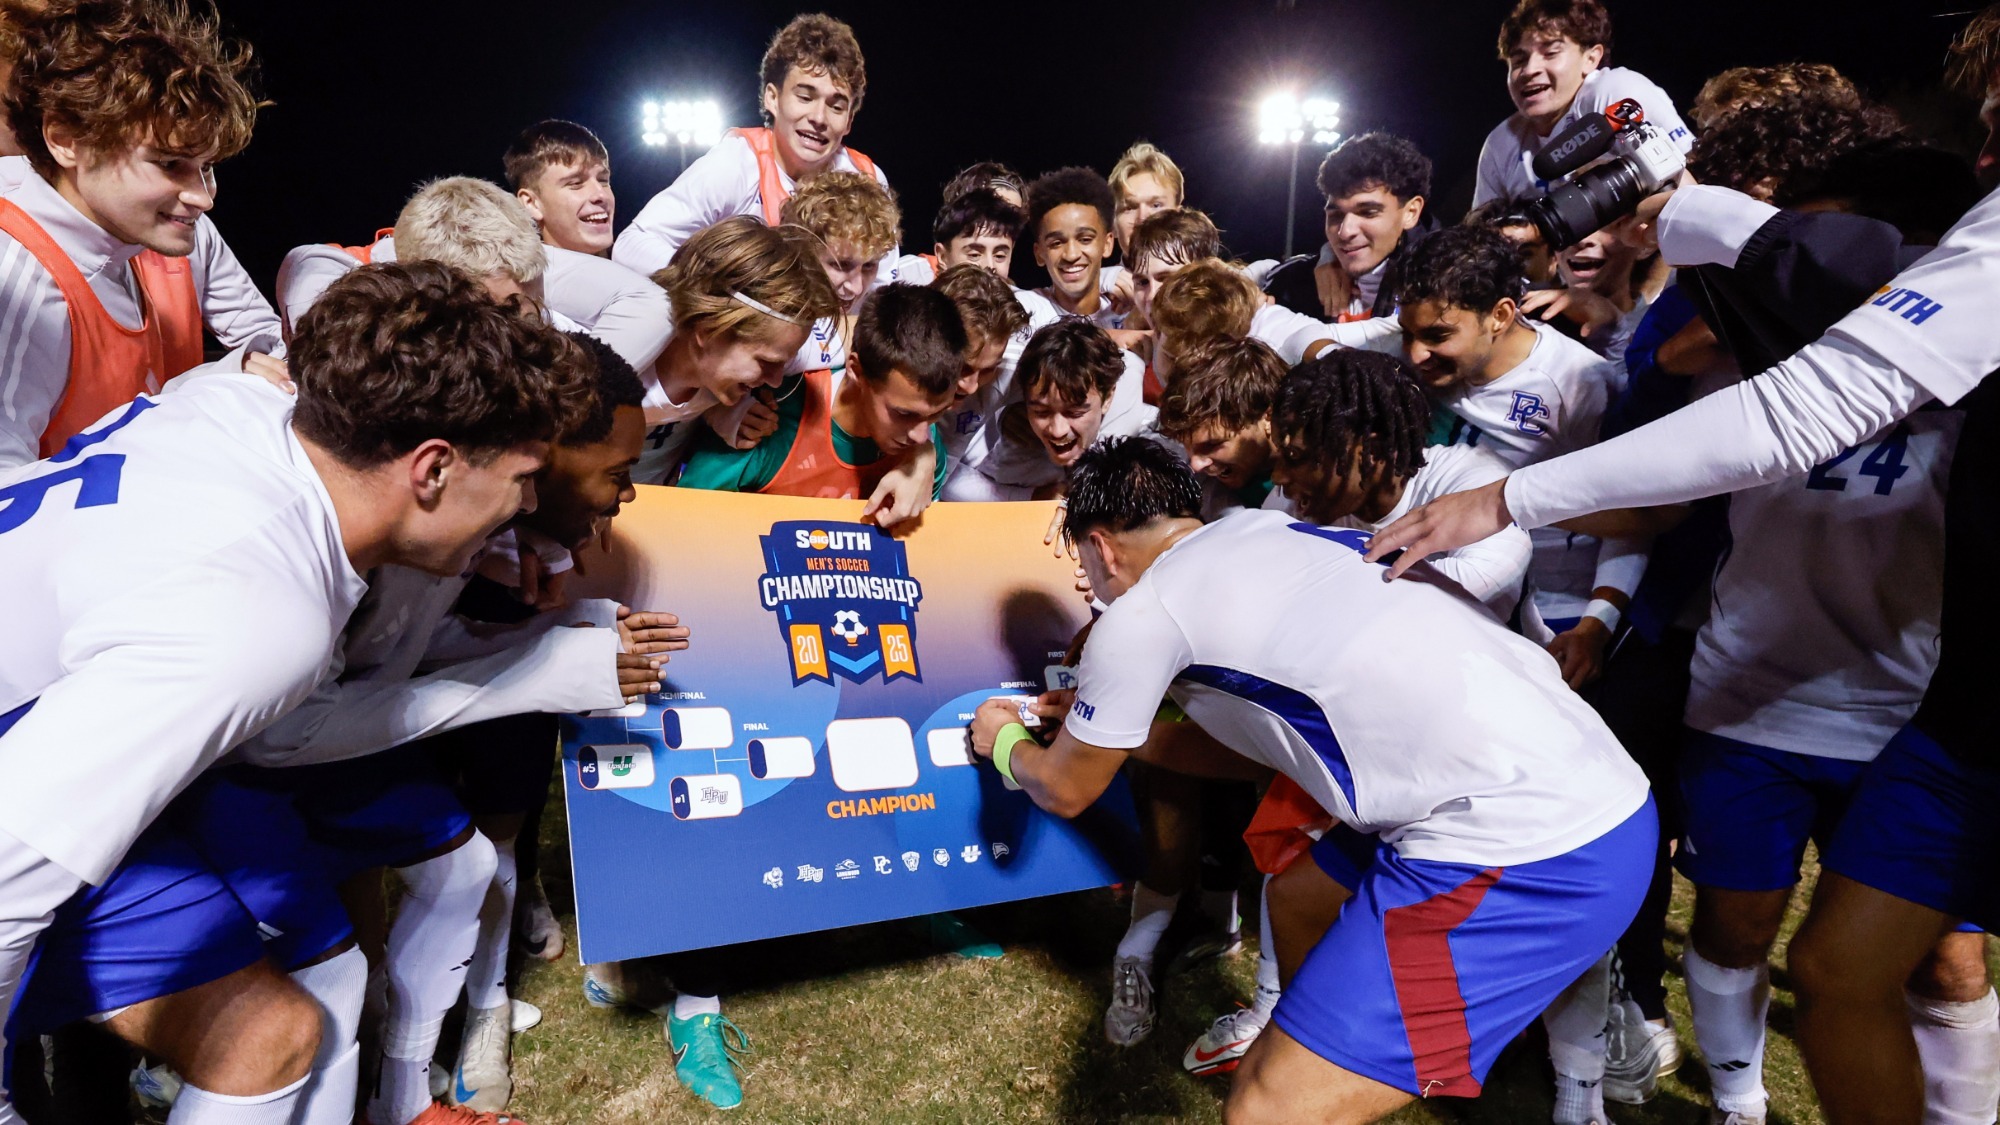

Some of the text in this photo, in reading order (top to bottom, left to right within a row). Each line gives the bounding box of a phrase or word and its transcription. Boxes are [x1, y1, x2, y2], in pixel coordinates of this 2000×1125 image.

[1550, 123, 1602, 163] RØDE
[1866, 286, 1943, 326] UTH
[1504, 390, 1550, 436] PC
[795, 529, 872, 551] SOUTH
[806, 557, 870, 572] MEN'S SOCCER
[762, 574, 919, 607] CHAMPIONSHIP
[796, 635, 819, 664] 20
[887, 635, 909, 663] 25
[1000, 681, 1037, 689] SEMIFINAL
[659, 691, 706, 700] SEMIFINAL
[743, 722, 769, 731] FINAL
[582, 763, 596, 773] #5
[675, 794, 685, 804] #1
[701, 786, 728, 805] HPU
[826, 793, 936, 819] CHAMPION
[796, 864, 824, 883] HPU
[873, 855, 893, 875] PC
